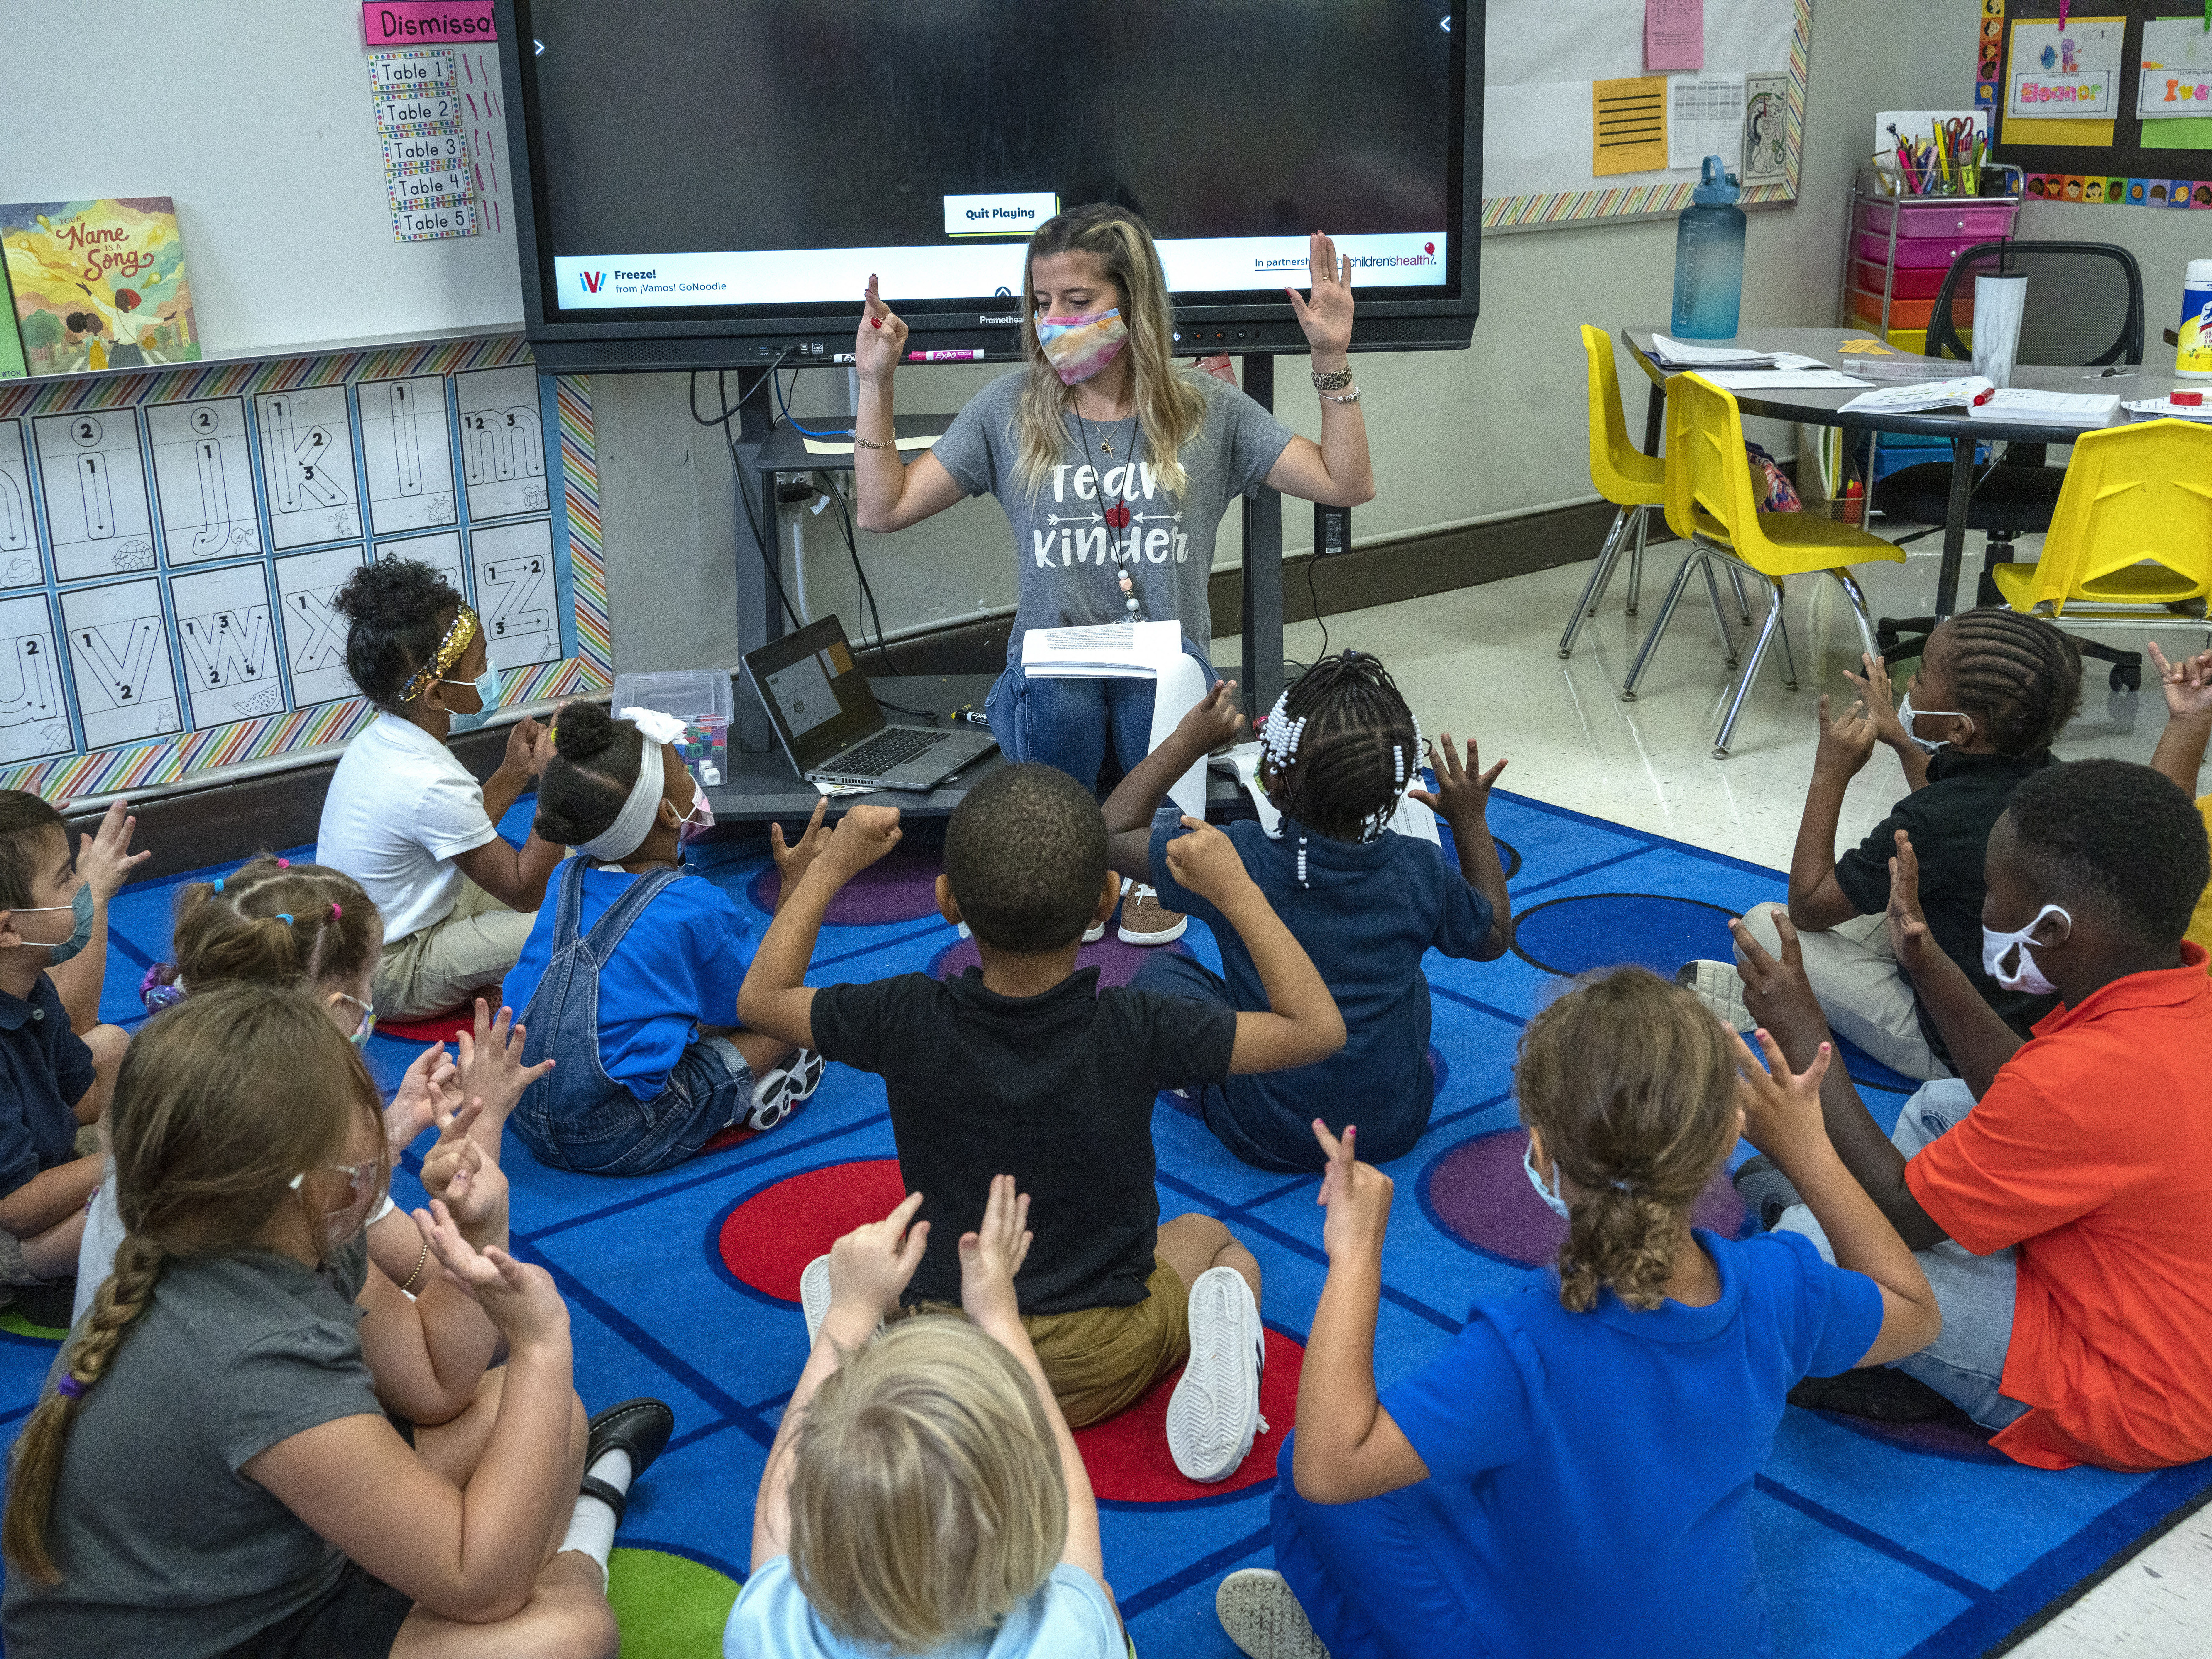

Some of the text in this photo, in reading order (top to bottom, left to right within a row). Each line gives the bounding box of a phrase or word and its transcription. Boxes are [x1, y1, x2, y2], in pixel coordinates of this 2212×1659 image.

[381, 8, 497, 37] Dismissal
[382, 61, 442, 80] Table 1
[2021, 82, 2102, 103] Eleanor
[387, 101, 448, 121] Table 2
[394, 139, 456, 159] Table 3
[399, 174, 459, 196] Table 4
[59, 215, 82, 225] YOUR
[966, 207, 1035, 220] Quit Playing
[404, 211, 465, 231] Table 5
[56, 222, 130, 250] Name
[84, 248, 155, 282] Song
[1255, 257, 1309, 268] In partnersh
[614, 269, 656, 280] Freeze!
[616, 284, 637, 293] from
[679, 282, 727, 291] GoNoodle
[980, 316, 1024, 324] Promethea
[935, 352, 957, 360] EXPO
[396, 387, 405, 401] 1
[274, 402, 283, 416] 1
[198, 413, 211, 427] 2
[465, 416, 485, 430] 1 2
[506, 414, 516, 427] 3
[80, 423, 94, 439] 2
[313, 432, 324, 447] 2
[204, 445, 213, 459] 1
[86, 459, 96, 474] 1
[304, 465, 314, 480] 3
[488, 567, 497, 580] 1
[531, 560, 541, 573] 2
[298, 596, 306, 610] 1
[186, 622, 195, 636] 1
[218, 615, 230, 629] 3
[495, 622, 505, 635] 3
[26, 640, 39, 656] 2
[83, 634, 92, 648] 1
[209, 670, 221, 684] 2
[246, 665, 256, 677] 4
[120, 685, 133, 700] 2
